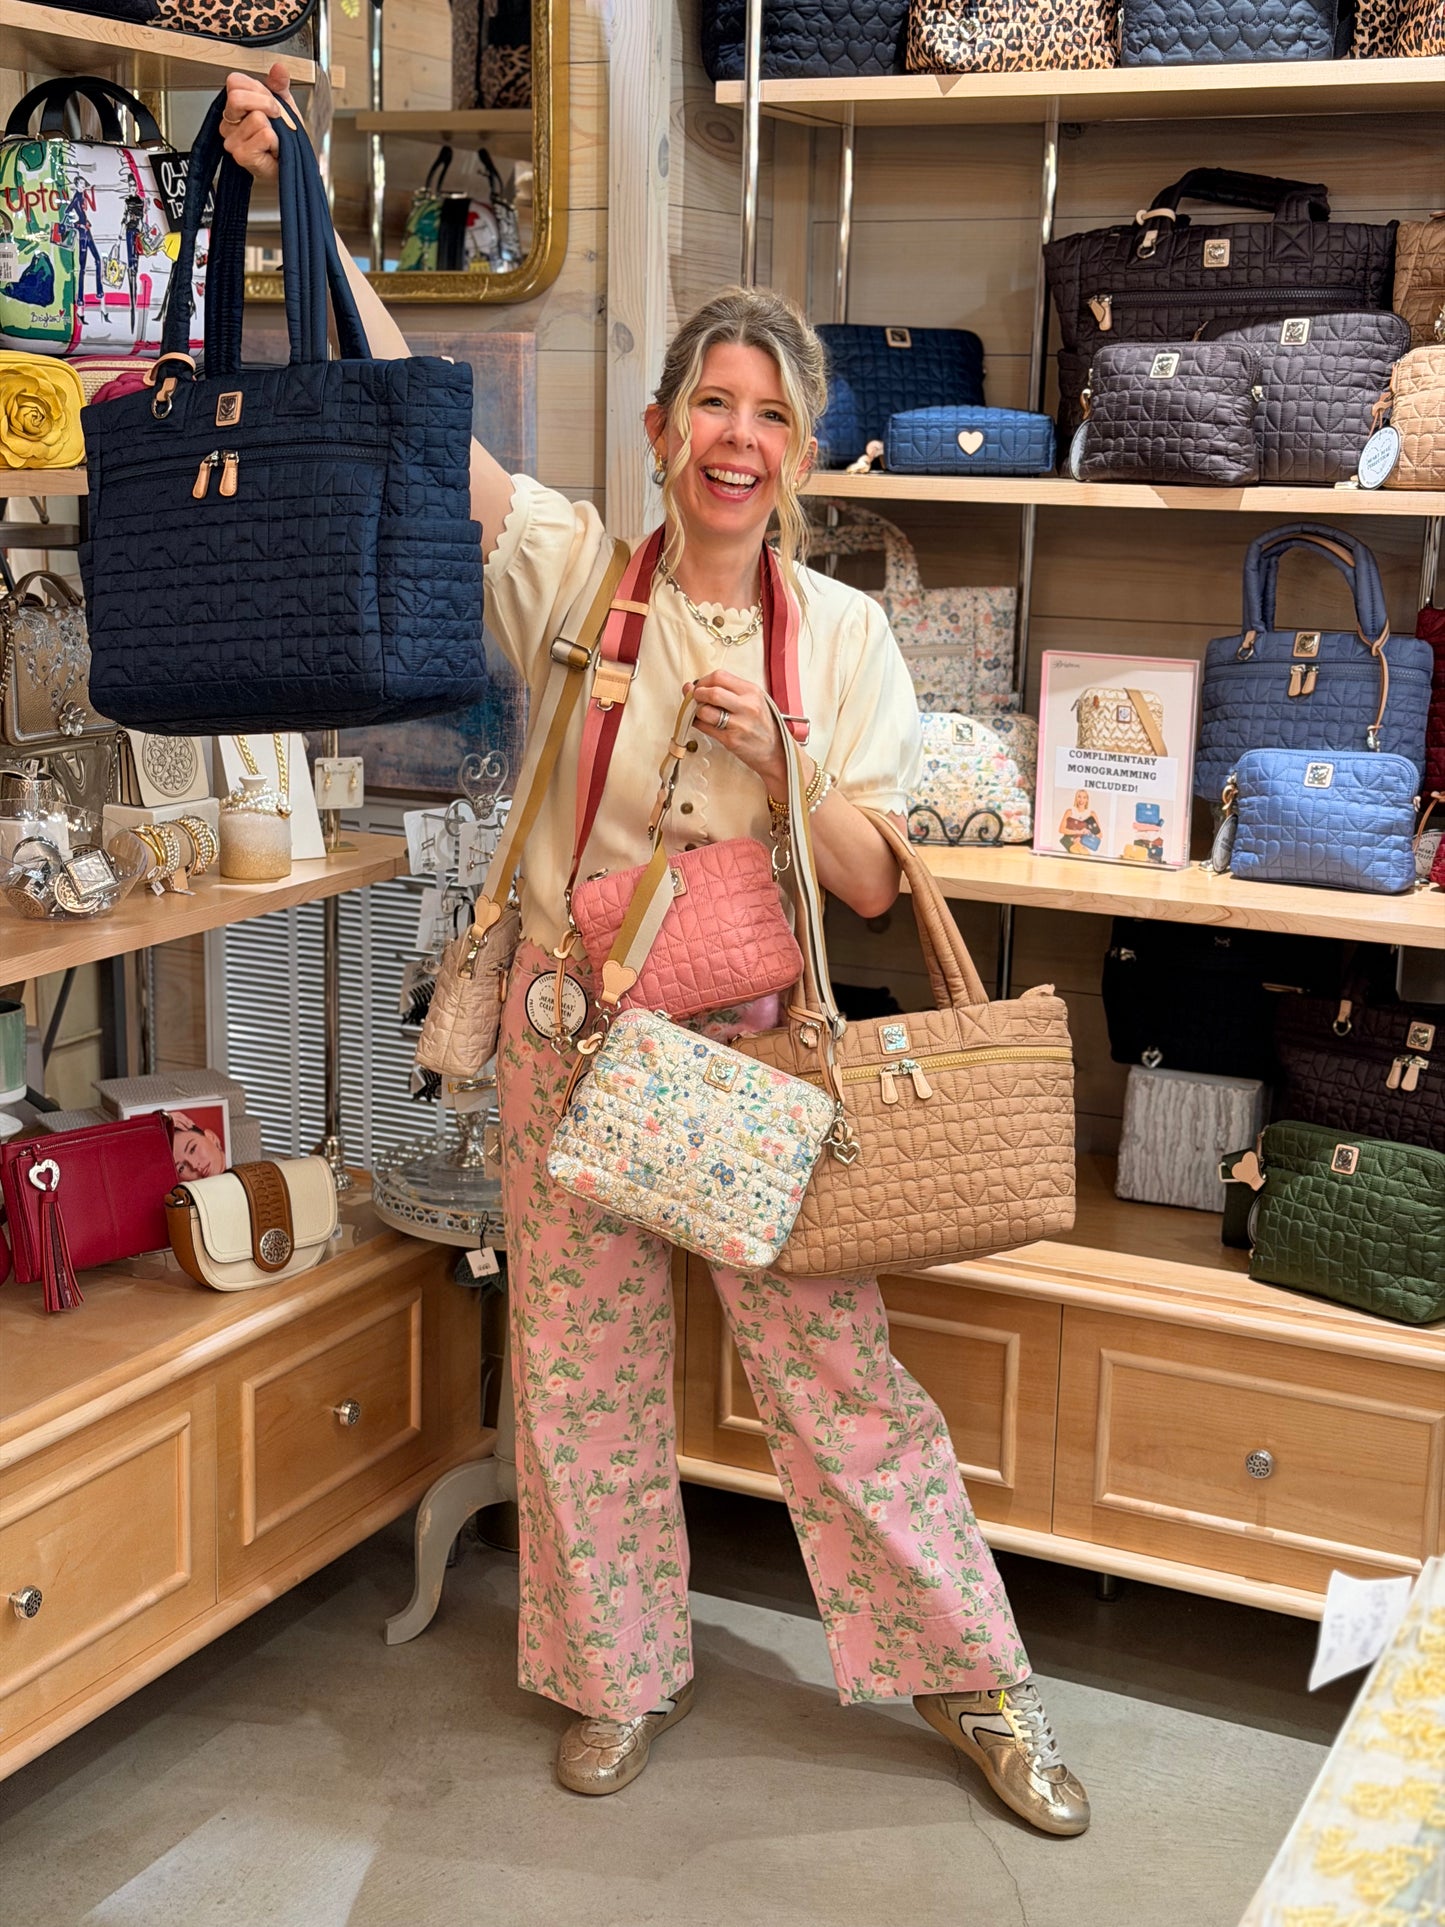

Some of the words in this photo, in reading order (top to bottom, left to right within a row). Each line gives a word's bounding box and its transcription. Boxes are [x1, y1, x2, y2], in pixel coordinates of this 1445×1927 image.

[1069, 750, 1157, 766] COMPLIMENTARY
[1067, 764, 1156, 780] MONOGRAMMING
[1084, 779, 1138, 793] INCLUDED!
